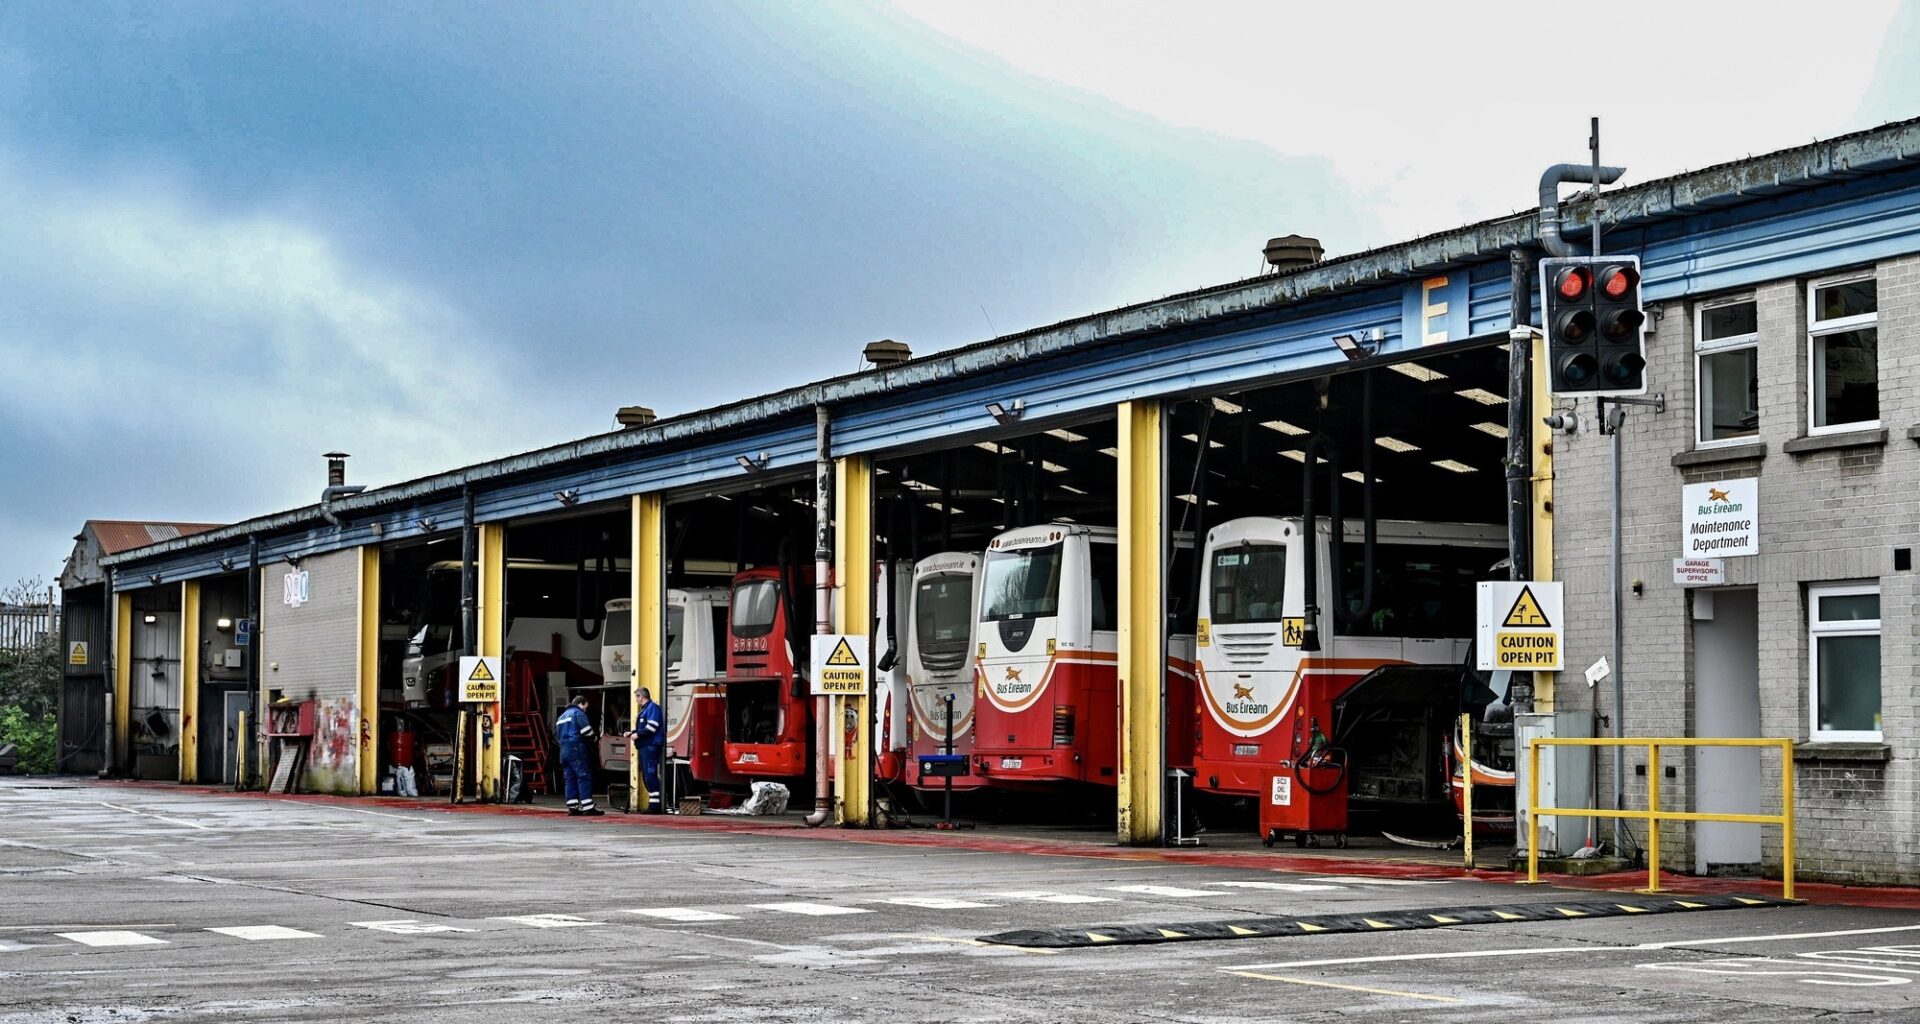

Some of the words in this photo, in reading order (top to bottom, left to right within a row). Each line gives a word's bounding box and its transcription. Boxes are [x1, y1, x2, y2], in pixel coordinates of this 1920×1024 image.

[1422, 276, 1449, 346] E
[1698, 506, 1712, 515] Bus
[1713, 502, 1743, 514] Éireann
[1690, 520, 1751, 535] Maintenance
[1692, 535, 1749, 553] Department
[1501, 636, 1554, 648] CAUTION
[1501, 652, 1532, 663] OPEN
[1535, 652, 1554, 663] PIT
[823, 672, 861, 680] CAUTION
[823, 682, 846, 690] OPEN
[847, 682, 861, 690] PIT
[996, 683, 1007, 694] Bus
[1226, 702, 1238, 713] Bus
[1240, 700, 1268, 714] Éireann
[930, 711, 939, 720] Bus
